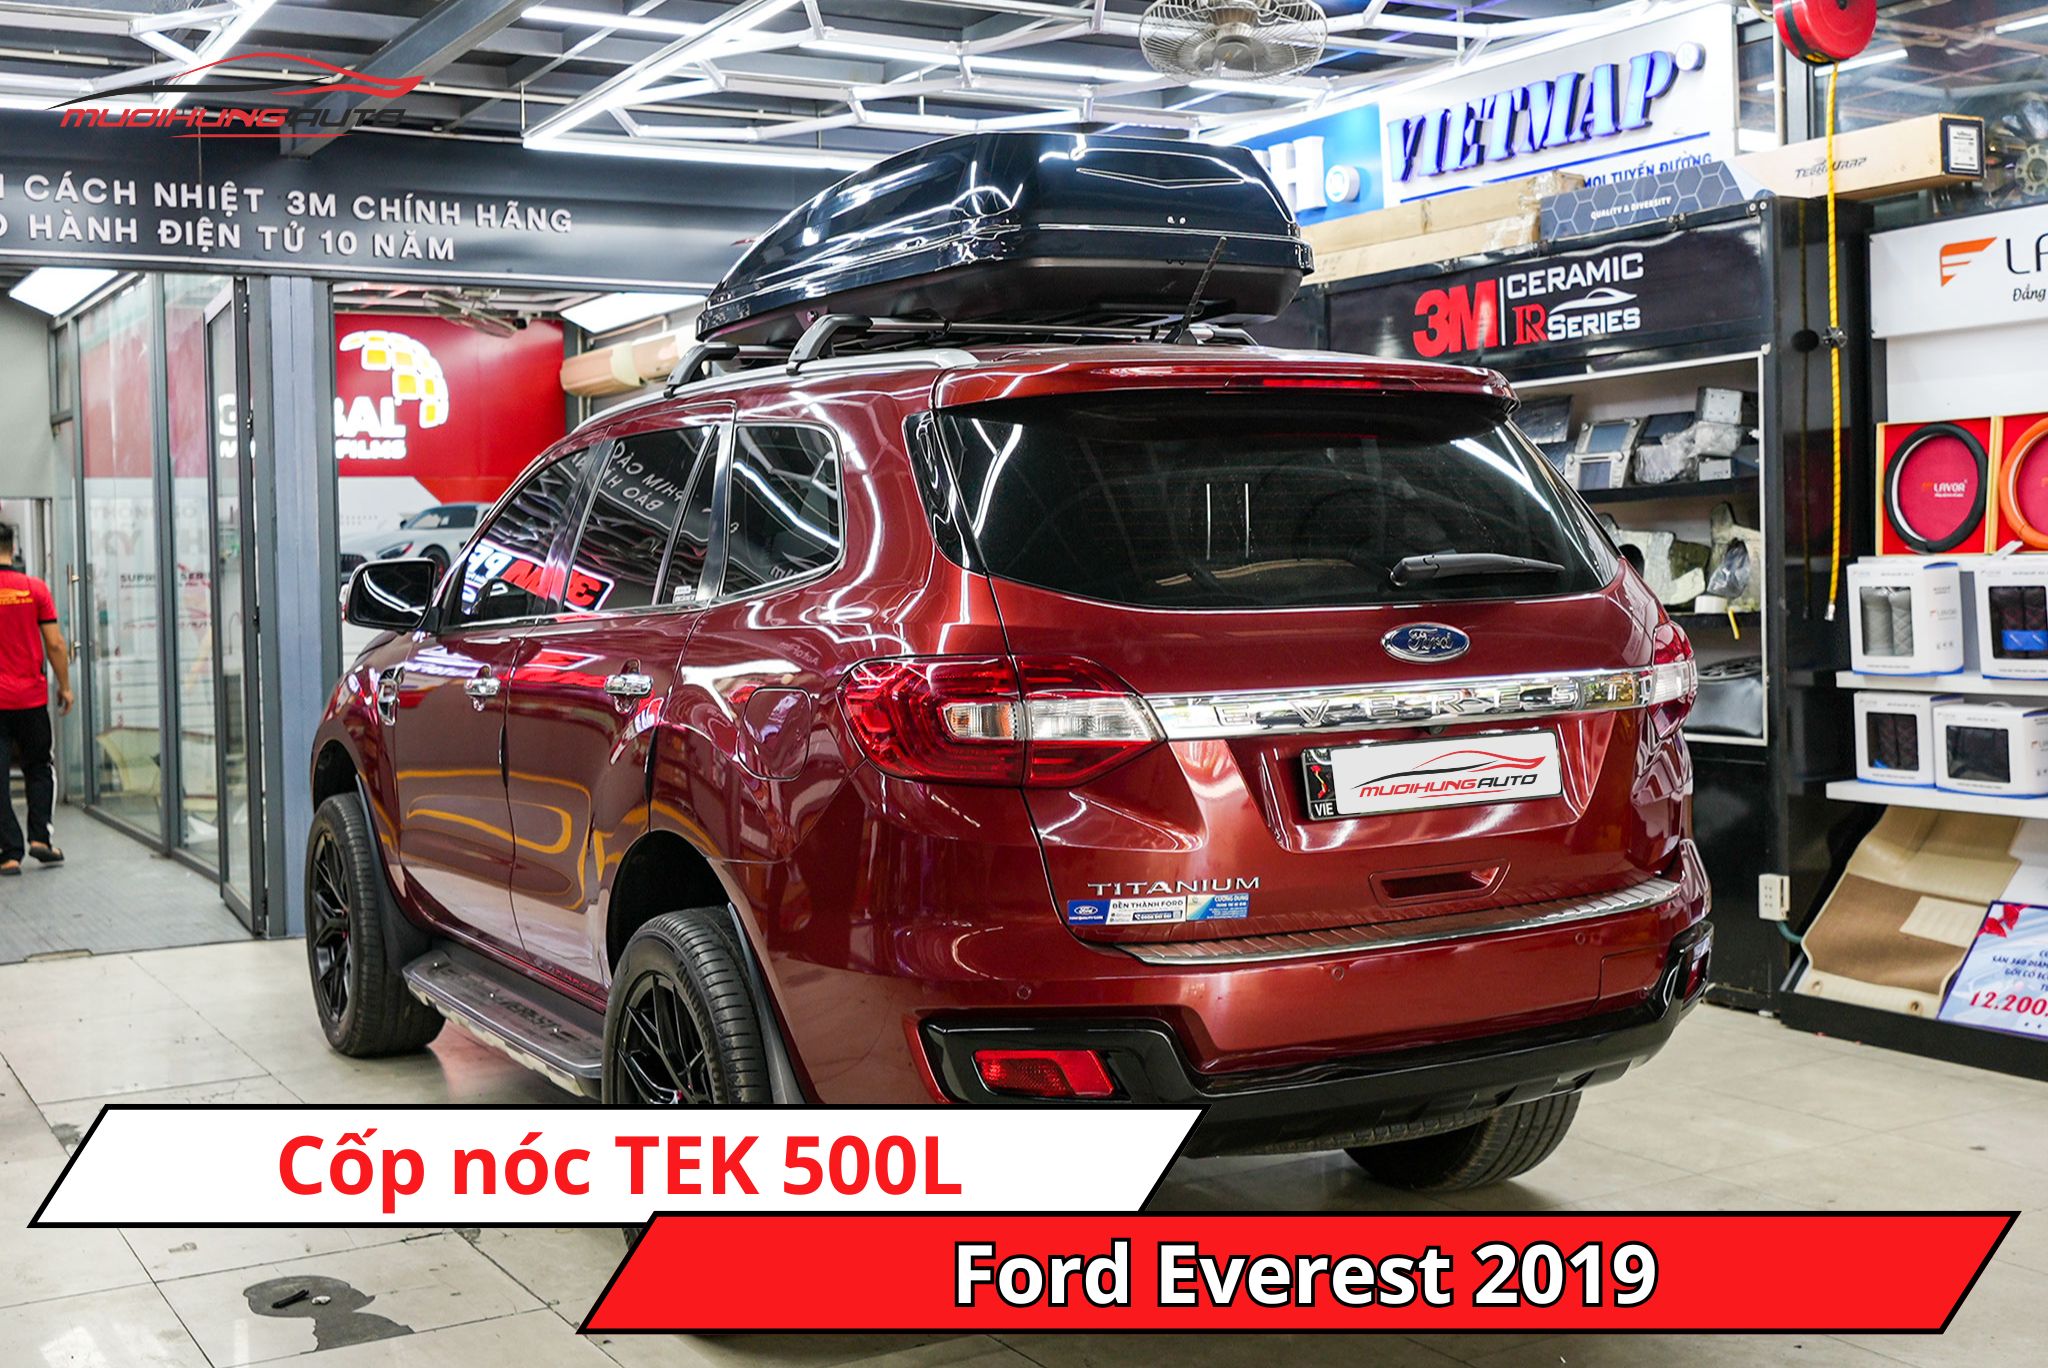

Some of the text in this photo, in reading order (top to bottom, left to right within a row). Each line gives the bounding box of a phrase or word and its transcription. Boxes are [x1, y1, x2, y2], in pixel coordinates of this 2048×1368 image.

[24, 170, 136, 205] CÁCH
[154, 181, 264, 217] NHIỆT
[286, 190, 336, 217] 3M
[352, 193, 460, 225] CHÍNH
[475, 201, 572, 232] HÃNG
[1591, 205, 1623, 220] QUALITY
[1631, 196, 1672, 212] DIVERSITY
[29, 208, 137, 243] HÀNH
[157, 216, 240, 252] ĐIỆN
[257, 221, 305, 253] TỬ
[320, 230, 357, 254] 10
[373, 230, 454, 260] NĂM
[1507, 252, 1644, 299] CERAMIC
[1412, 279, 1498, 357] 3M
[1408, 628, 1453, 653] Ford
[1314, 802, 1335, 817] VIE
[1088, 876, 1260, 896] TITANIUM
